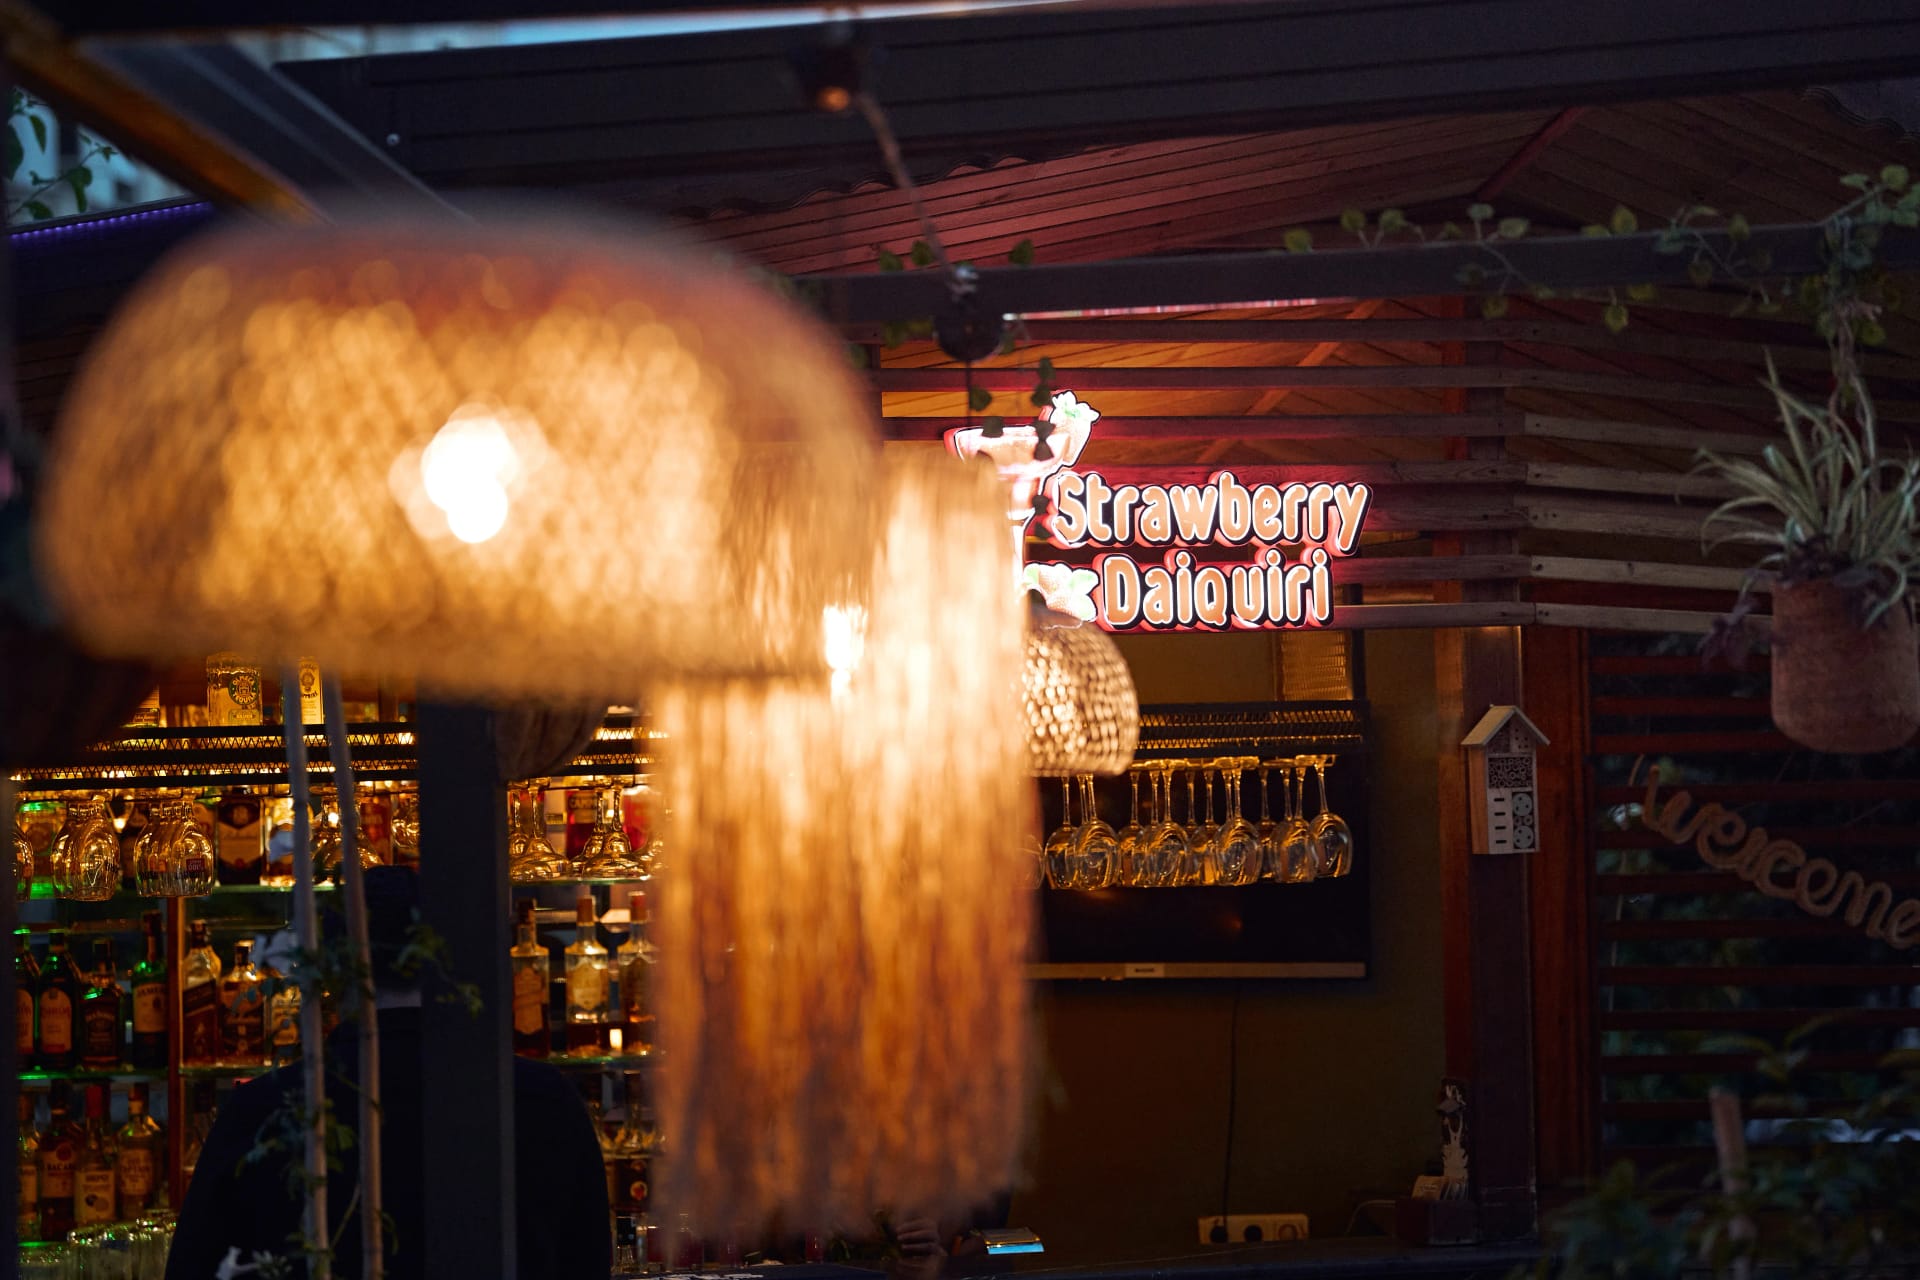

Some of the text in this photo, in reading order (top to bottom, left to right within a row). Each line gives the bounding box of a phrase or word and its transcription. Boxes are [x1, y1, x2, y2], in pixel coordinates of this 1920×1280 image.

[1055, 471, 1369, 553] Strawberry
[1102, 549, 1330, 626] Daiquiri
[232, 691, 257, 703] TEQUILA
